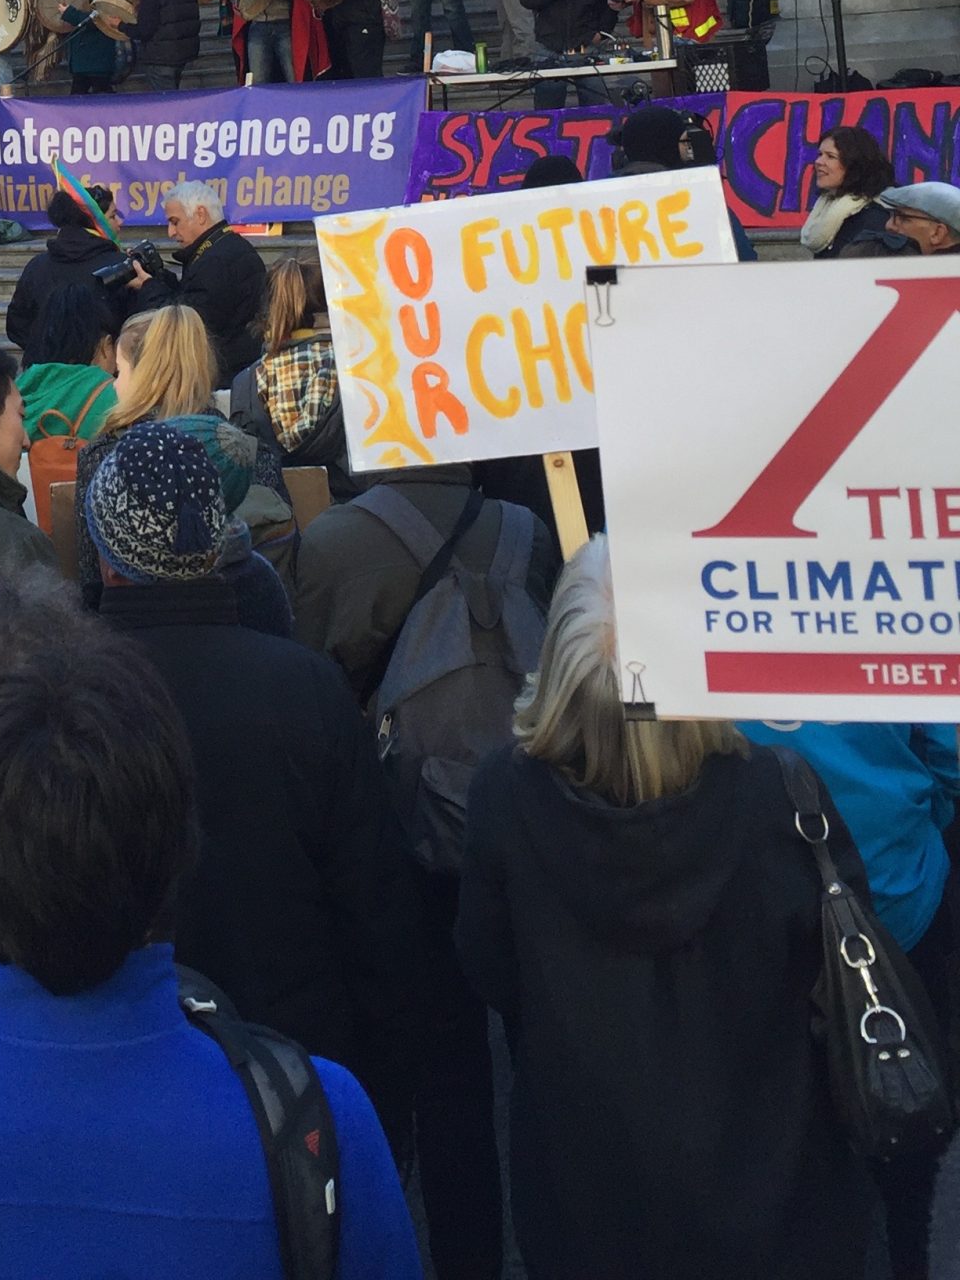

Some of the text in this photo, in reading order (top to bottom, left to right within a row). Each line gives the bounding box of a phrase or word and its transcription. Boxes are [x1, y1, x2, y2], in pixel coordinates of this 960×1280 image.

[430, 98, 960, 218] SYST CHAN
[128, 171, 228, 217] sysm
[236, 166, 350, 212] change
[460, 189, 704, 293] FUTURE
[383, 227, 469, 439] OUR
[700, 560, 960, 601] CLIMAT
[705, 610, 960, 635] FOR THE ROO
[860, 663, 960, 685] TIBET.
